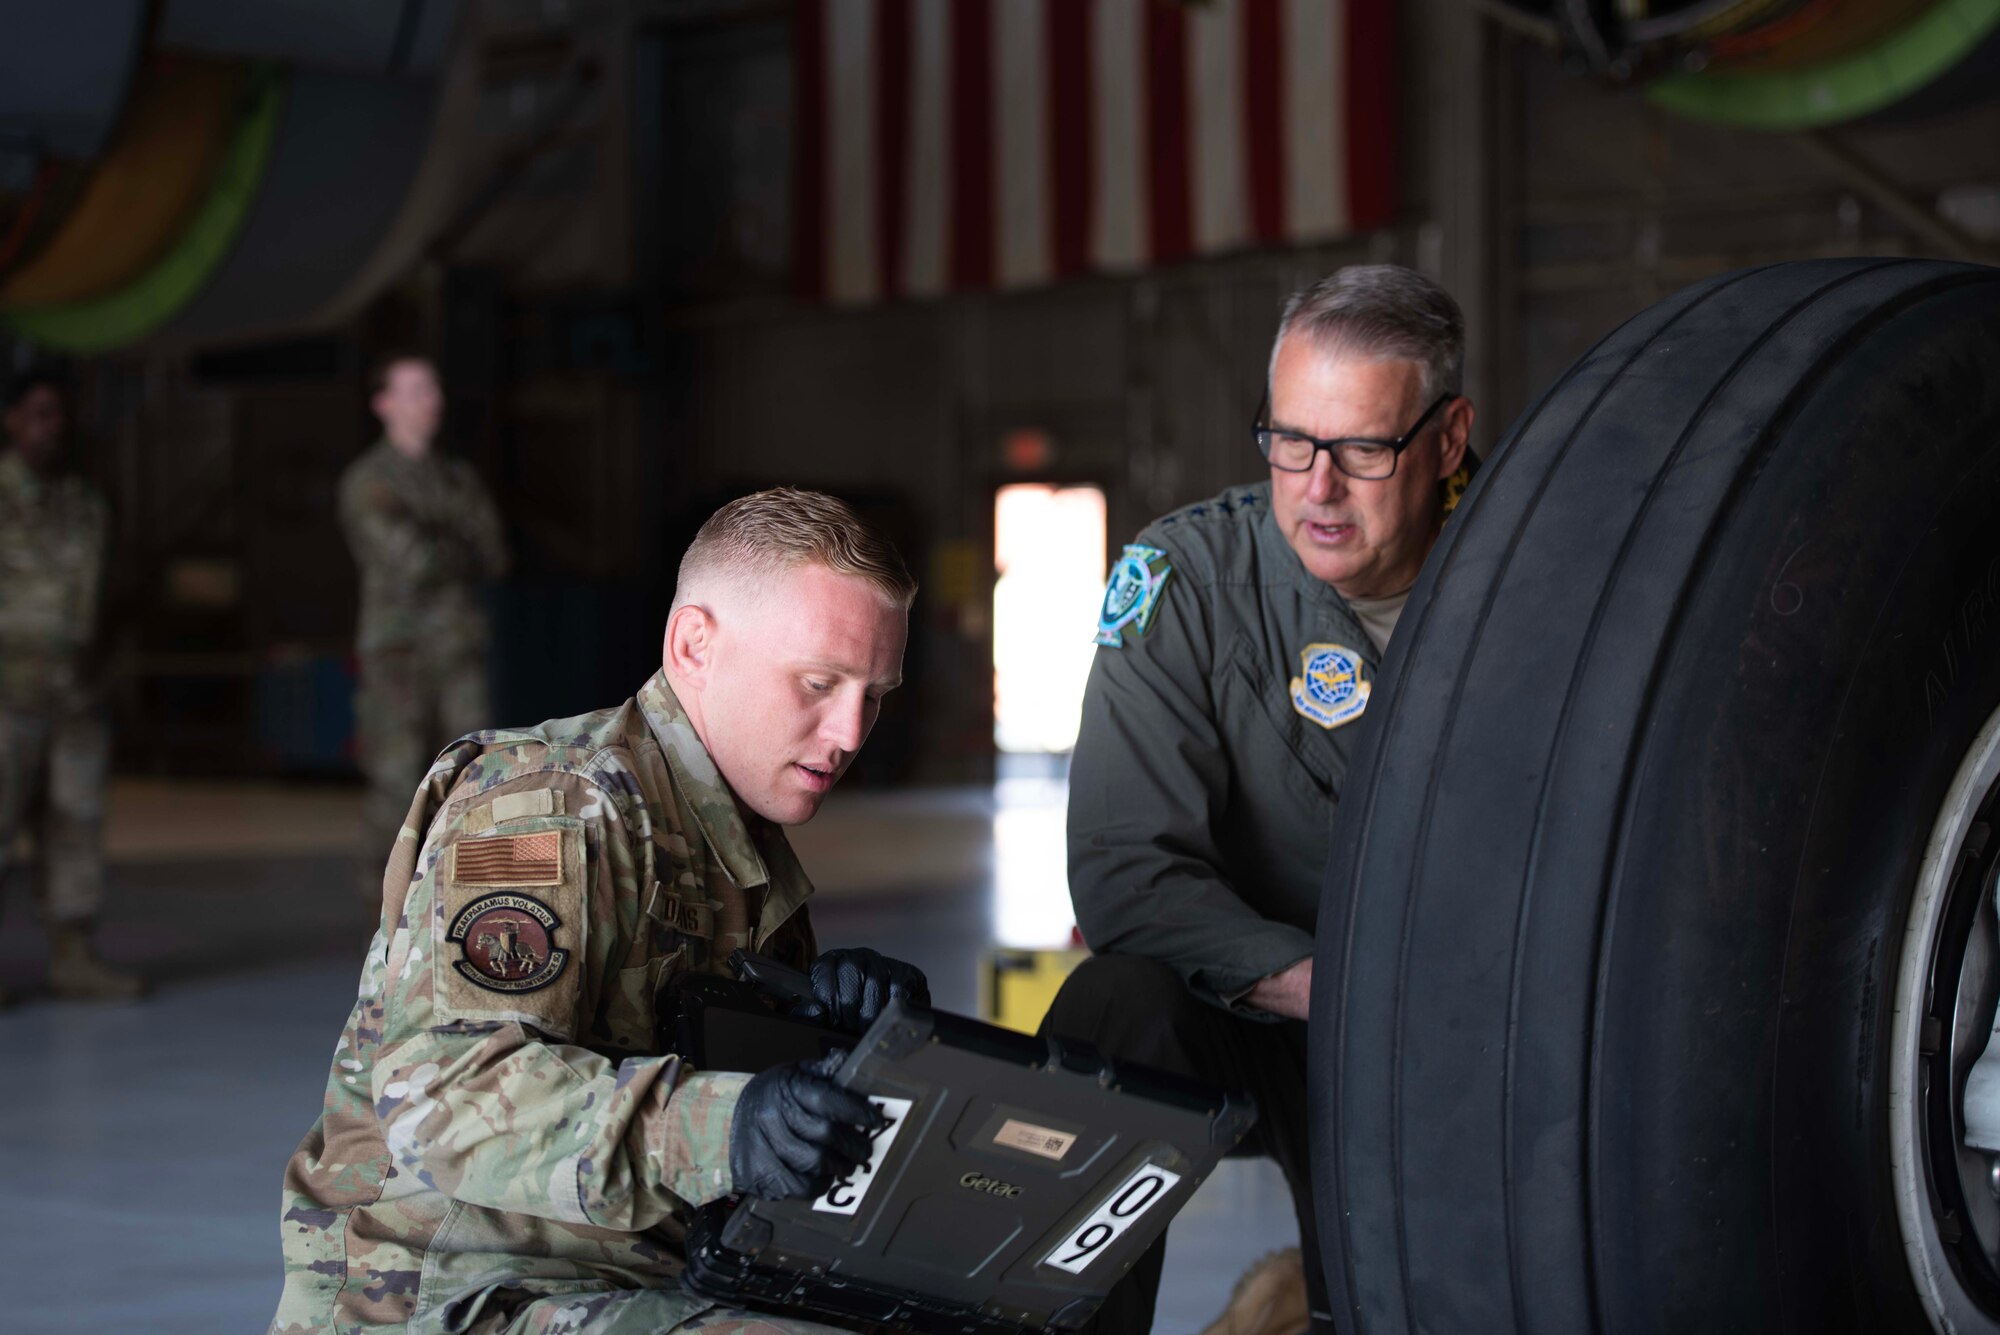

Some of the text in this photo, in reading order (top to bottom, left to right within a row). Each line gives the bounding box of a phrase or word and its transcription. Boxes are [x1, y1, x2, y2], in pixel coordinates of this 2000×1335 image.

[454, 897, 552, 937] PRAEPARAMUS VOLATUS
[513, 962, 558, 989] MAINTENANCE
[959, 1172, 1025, 1200] Getac
